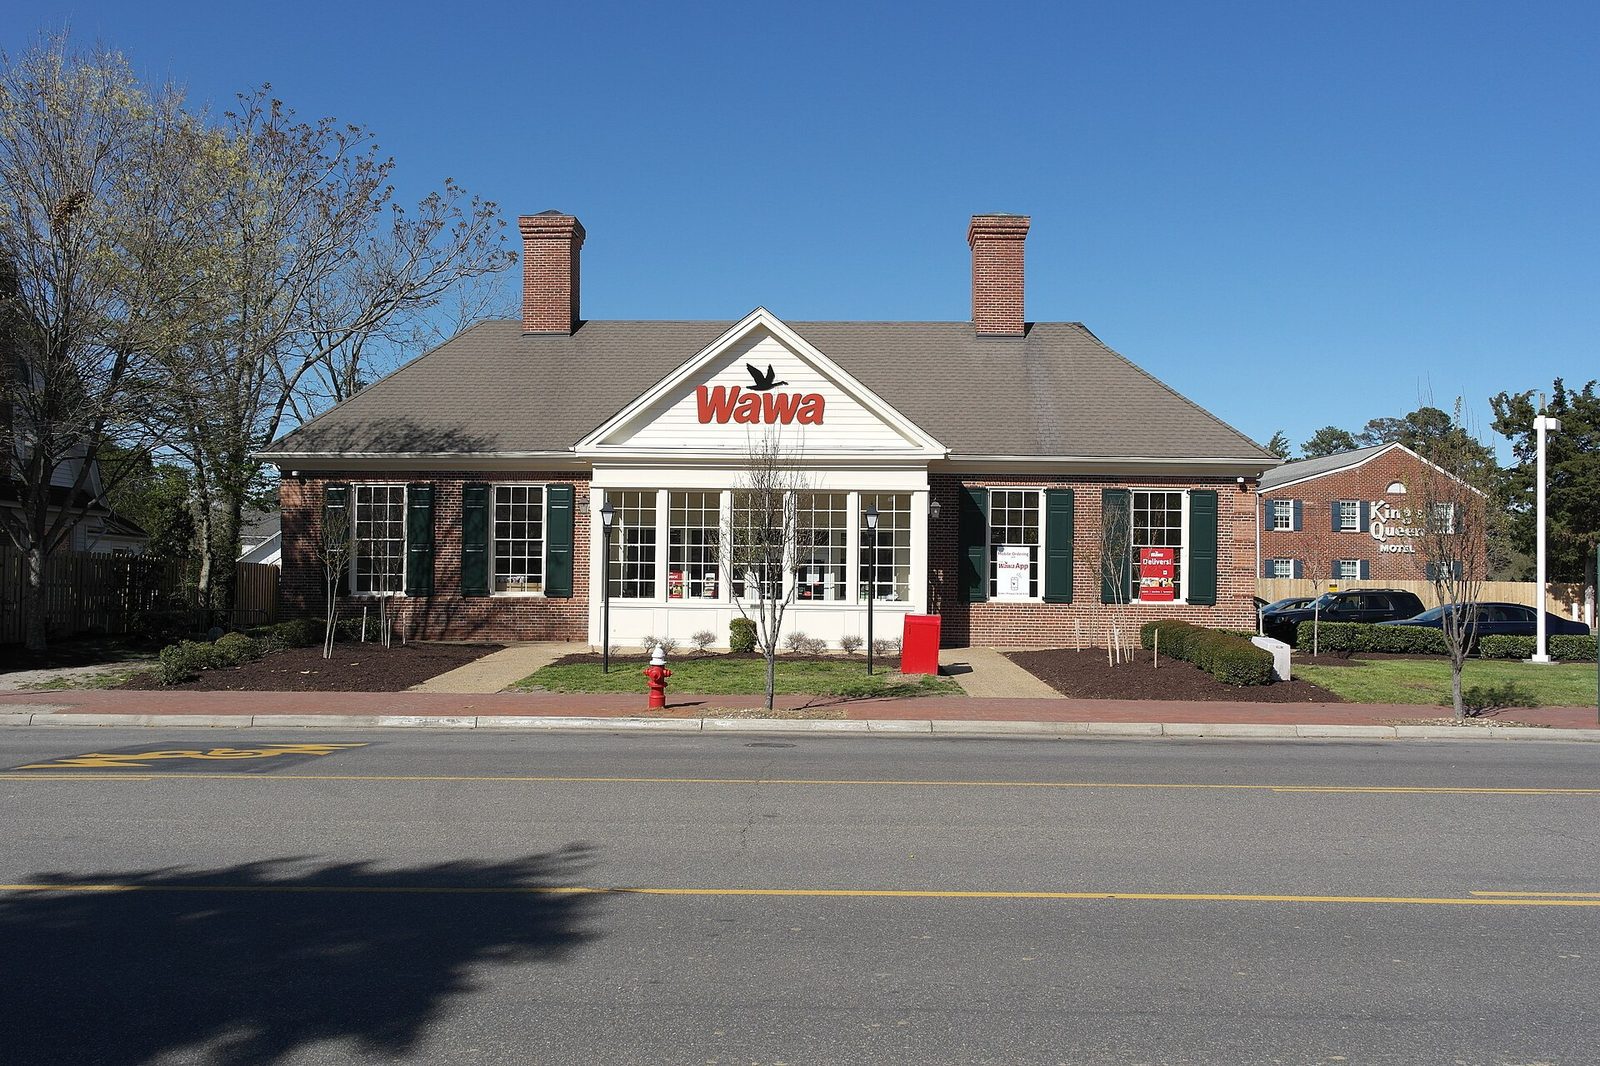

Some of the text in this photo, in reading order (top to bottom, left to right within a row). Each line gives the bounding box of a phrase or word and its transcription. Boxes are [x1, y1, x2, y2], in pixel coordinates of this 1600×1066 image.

[696, 385, 826, 425] Wawa
[1370, 499, 1411, 525] King
[1370, 521, 1425, 542] Queen
[1380, 544, 1416, 553] MOTEL
[1015, 562, 1029, 570] App
